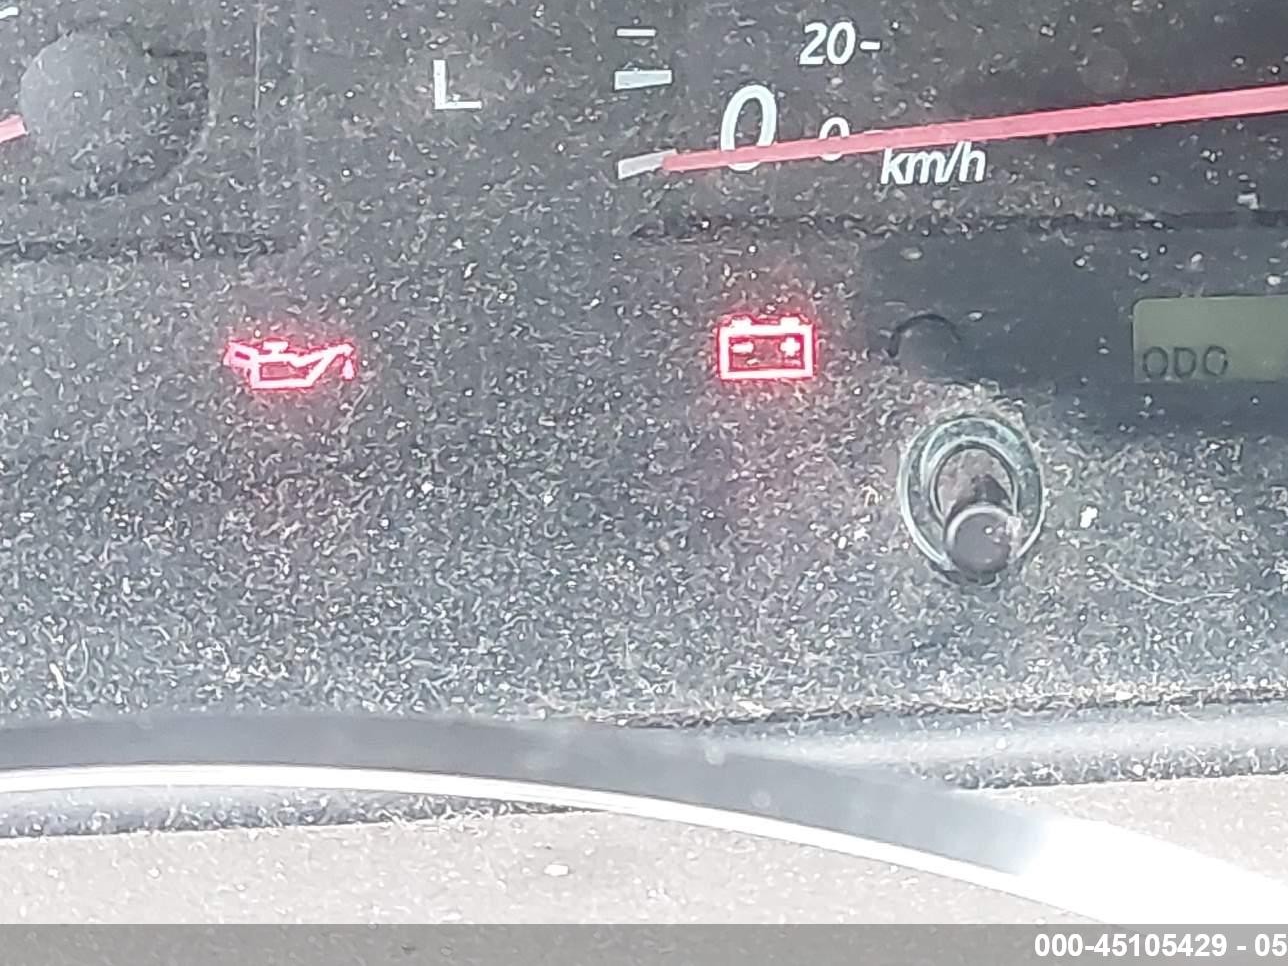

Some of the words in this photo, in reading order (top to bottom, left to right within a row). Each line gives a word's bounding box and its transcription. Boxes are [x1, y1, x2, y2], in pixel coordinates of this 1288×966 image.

[800, 21, 855, 65] 20
[432, 58, 482, 110] L
[720, 84, 777, 171] 0
[880, 142, 987, 186] km/h
[1141, 345, 1230, 380] ODO
